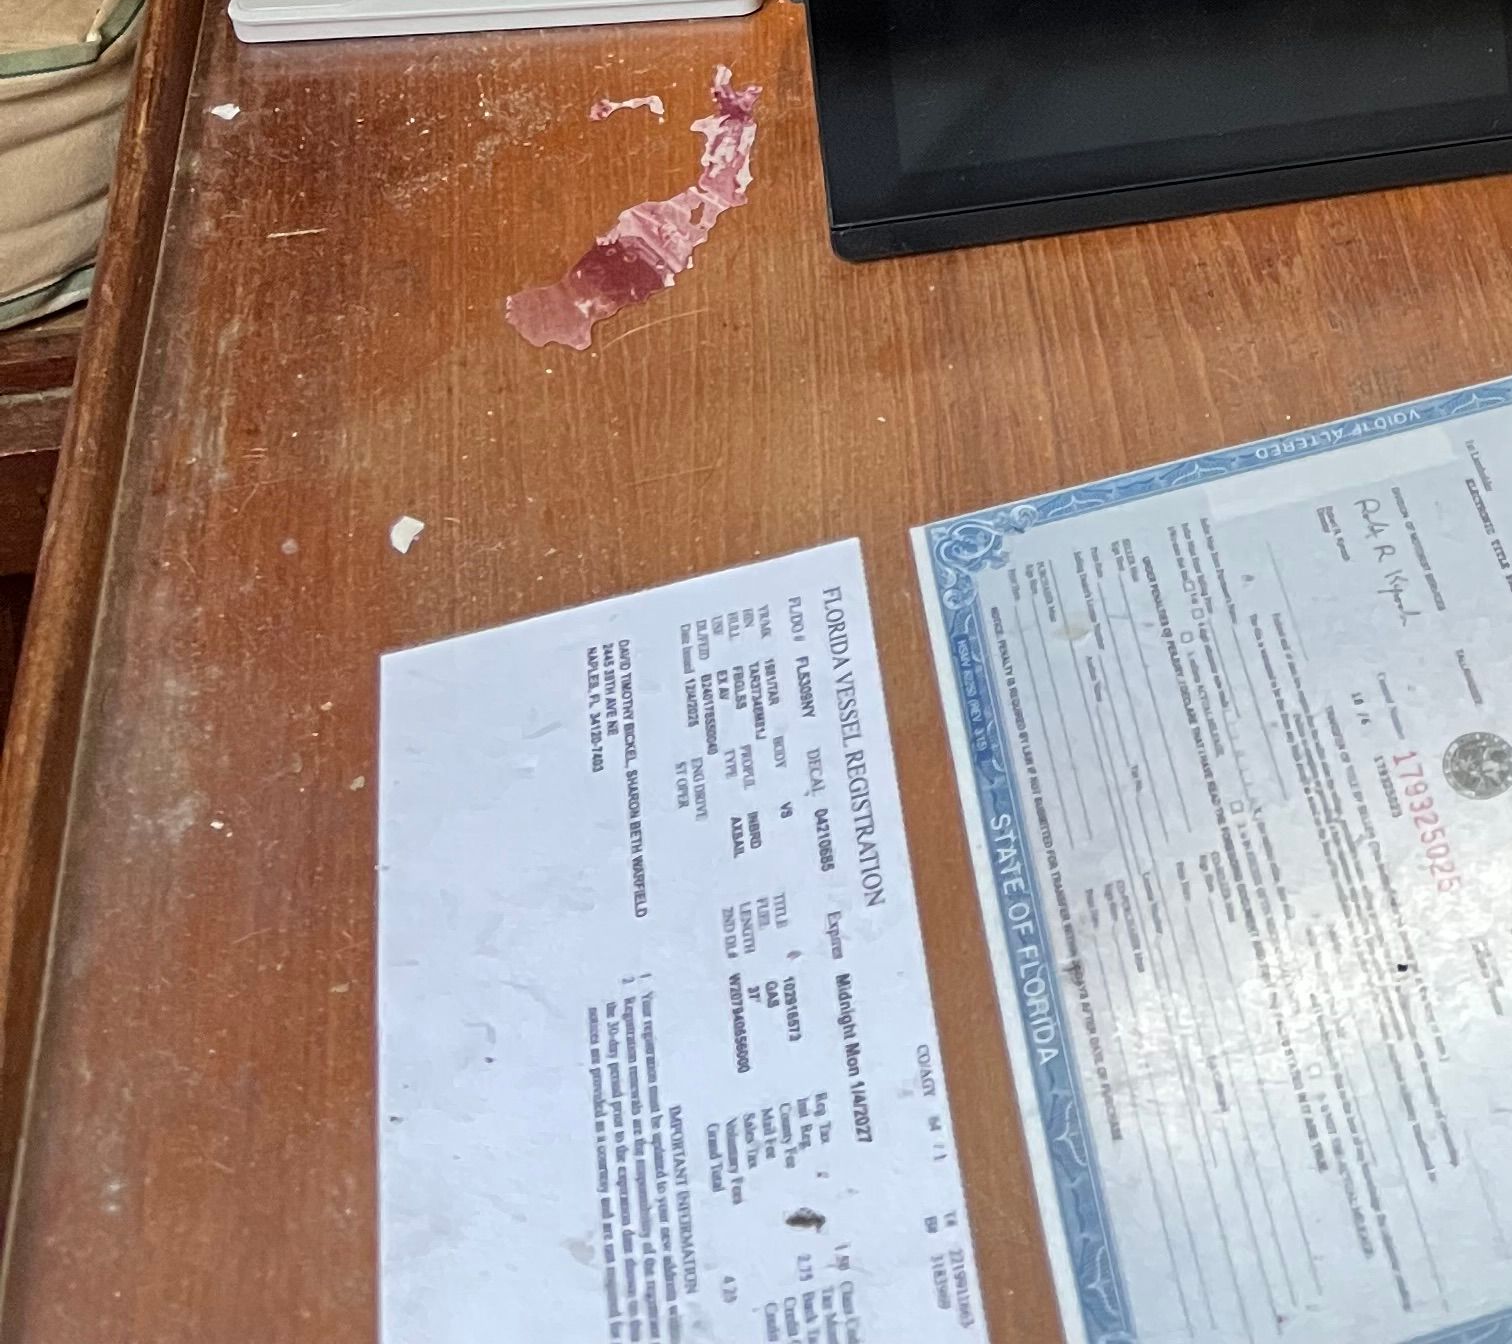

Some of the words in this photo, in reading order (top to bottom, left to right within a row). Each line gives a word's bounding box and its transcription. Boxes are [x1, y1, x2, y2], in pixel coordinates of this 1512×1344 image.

[1255, 427, 1344, 460] ALTERED
[1374, 409, 1421, 431] VOID
[617, 638, 630, 671] DAVID
[821, 585, 852, 670] FLORIDA
[619, 672, 634, 721] TIMOTHY
[833, 670, 863, 748] VESSEL
[806, 747, 826, 797] DECAL
[844, 748, 887, 907] REGISTRATION
[985, 811, 1027, 896] STATE
[631, 855, 647, 919] WARFIELD
[1003, 899, 1036, 938] OF
[831, 972, 858, 1041] Midnight
[1012, 942, 1064, 1066] FLORIDA
[844, 1041, 863, 1077] Mon
[849, 1080, 872, 1146] 1/4/2027
